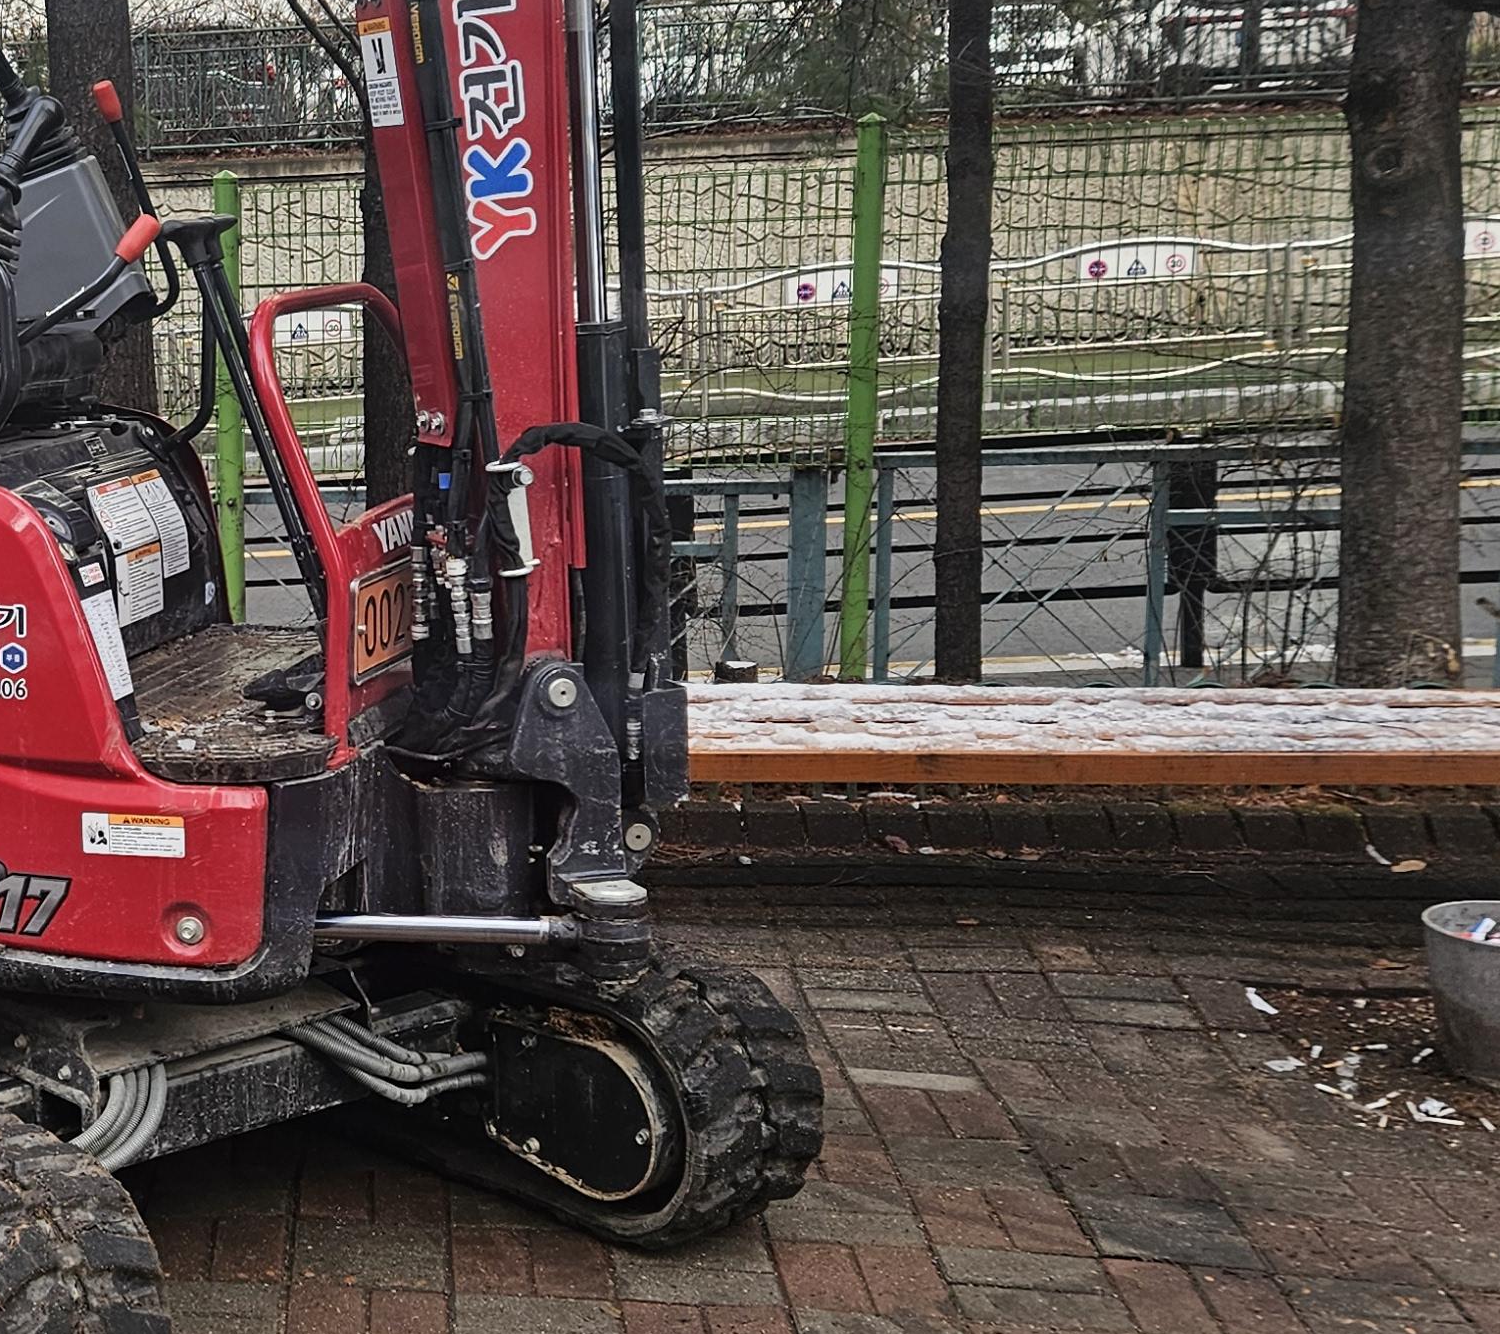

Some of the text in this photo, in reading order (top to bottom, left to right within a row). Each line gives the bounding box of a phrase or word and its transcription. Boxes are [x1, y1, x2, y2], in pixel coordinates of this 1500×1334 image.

[409, 0, 425, 64] VERDIGM
[364, 580, 412, 657] 002
[131, 817, 170, 826] WARNING
